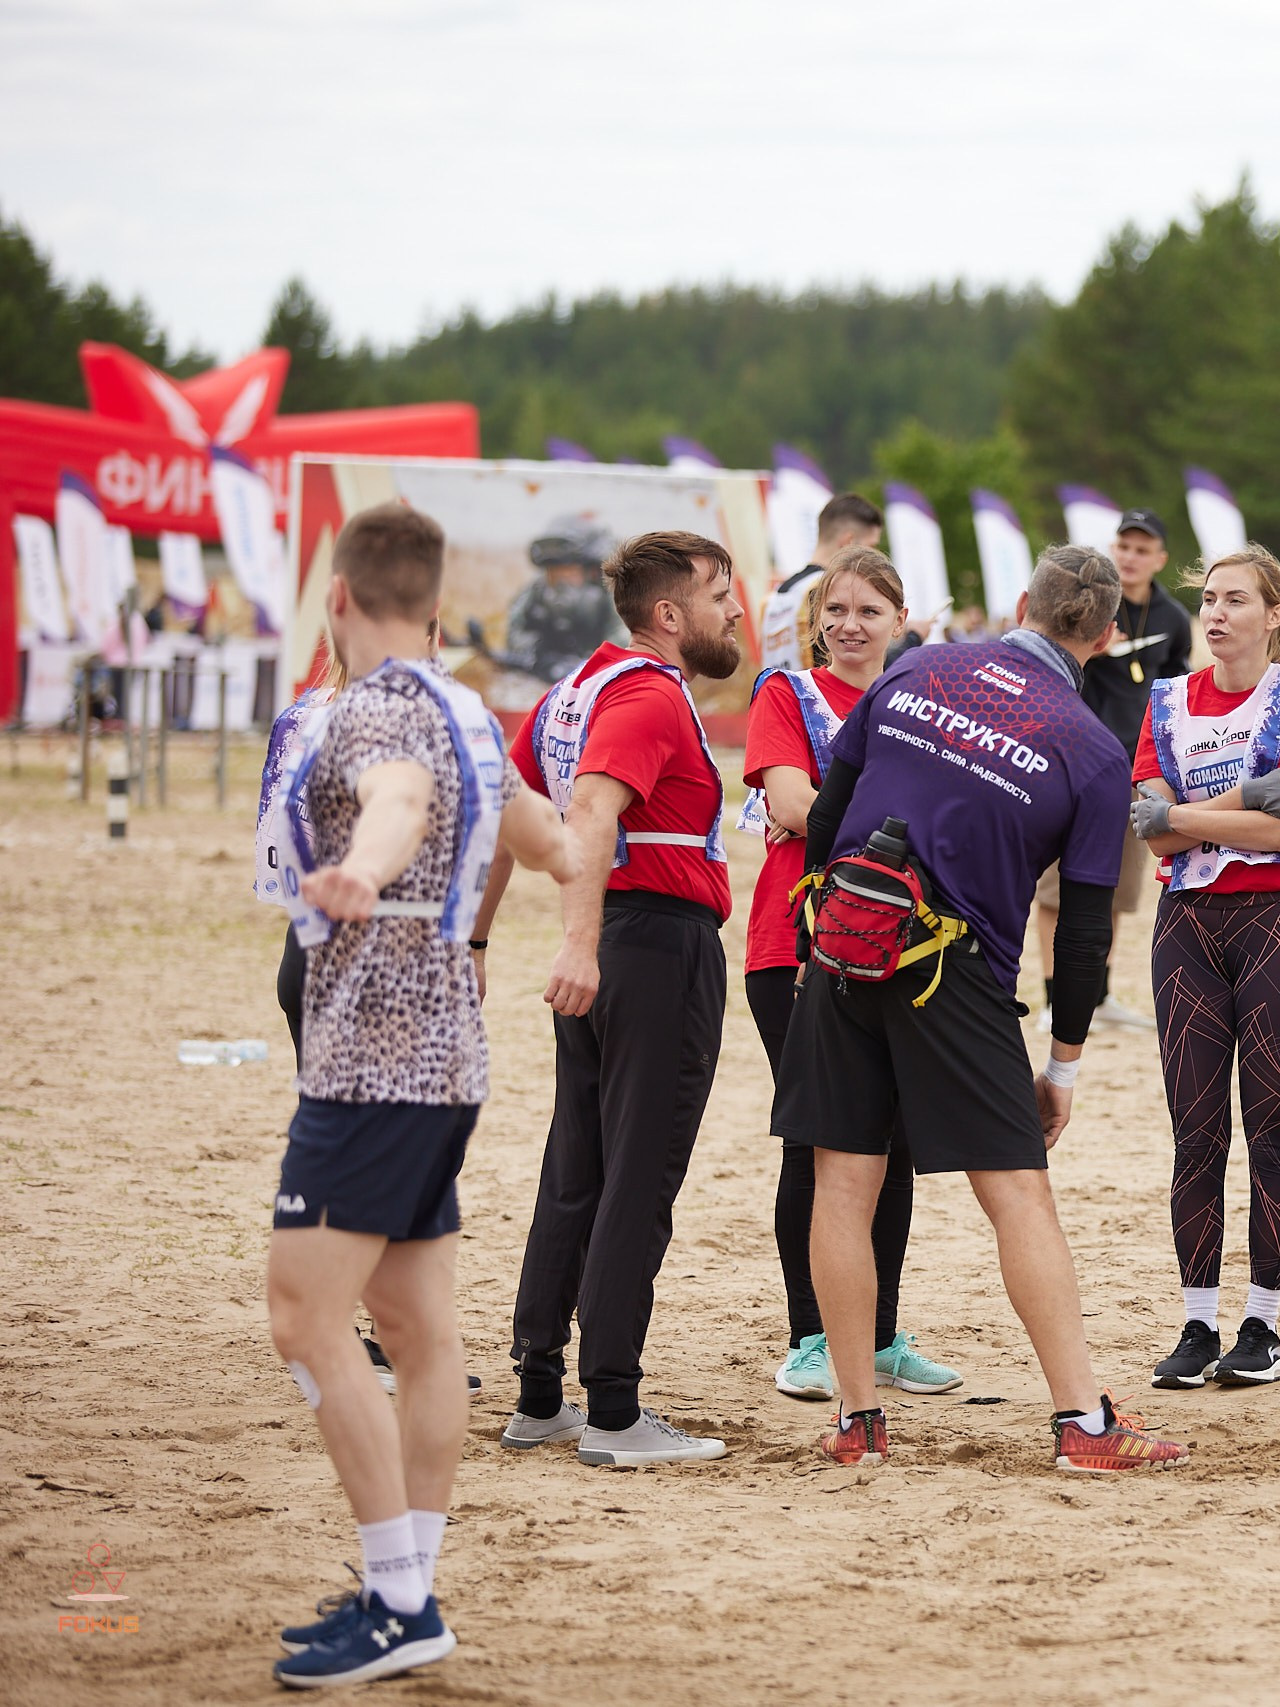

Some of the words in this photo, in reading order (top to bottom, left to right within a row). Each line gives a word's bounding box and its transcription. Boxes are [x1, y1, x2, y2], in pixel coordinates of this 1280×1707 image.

[984, 662, 1027, 686] ГОНКА
[973, 680, 1024, 696] ГЕРОЕВ
[886, 690, 1049, 774] ИНСТРУКТОР
[1185, 740, 1218, 755] ГОНКА
[1220, 730, 1251, 746] ГЕРОЕ
[1186, 760, 1243, 788] КОМАНД
[970, 772, 1032, 805] НАДЕЖНОСТЬ
